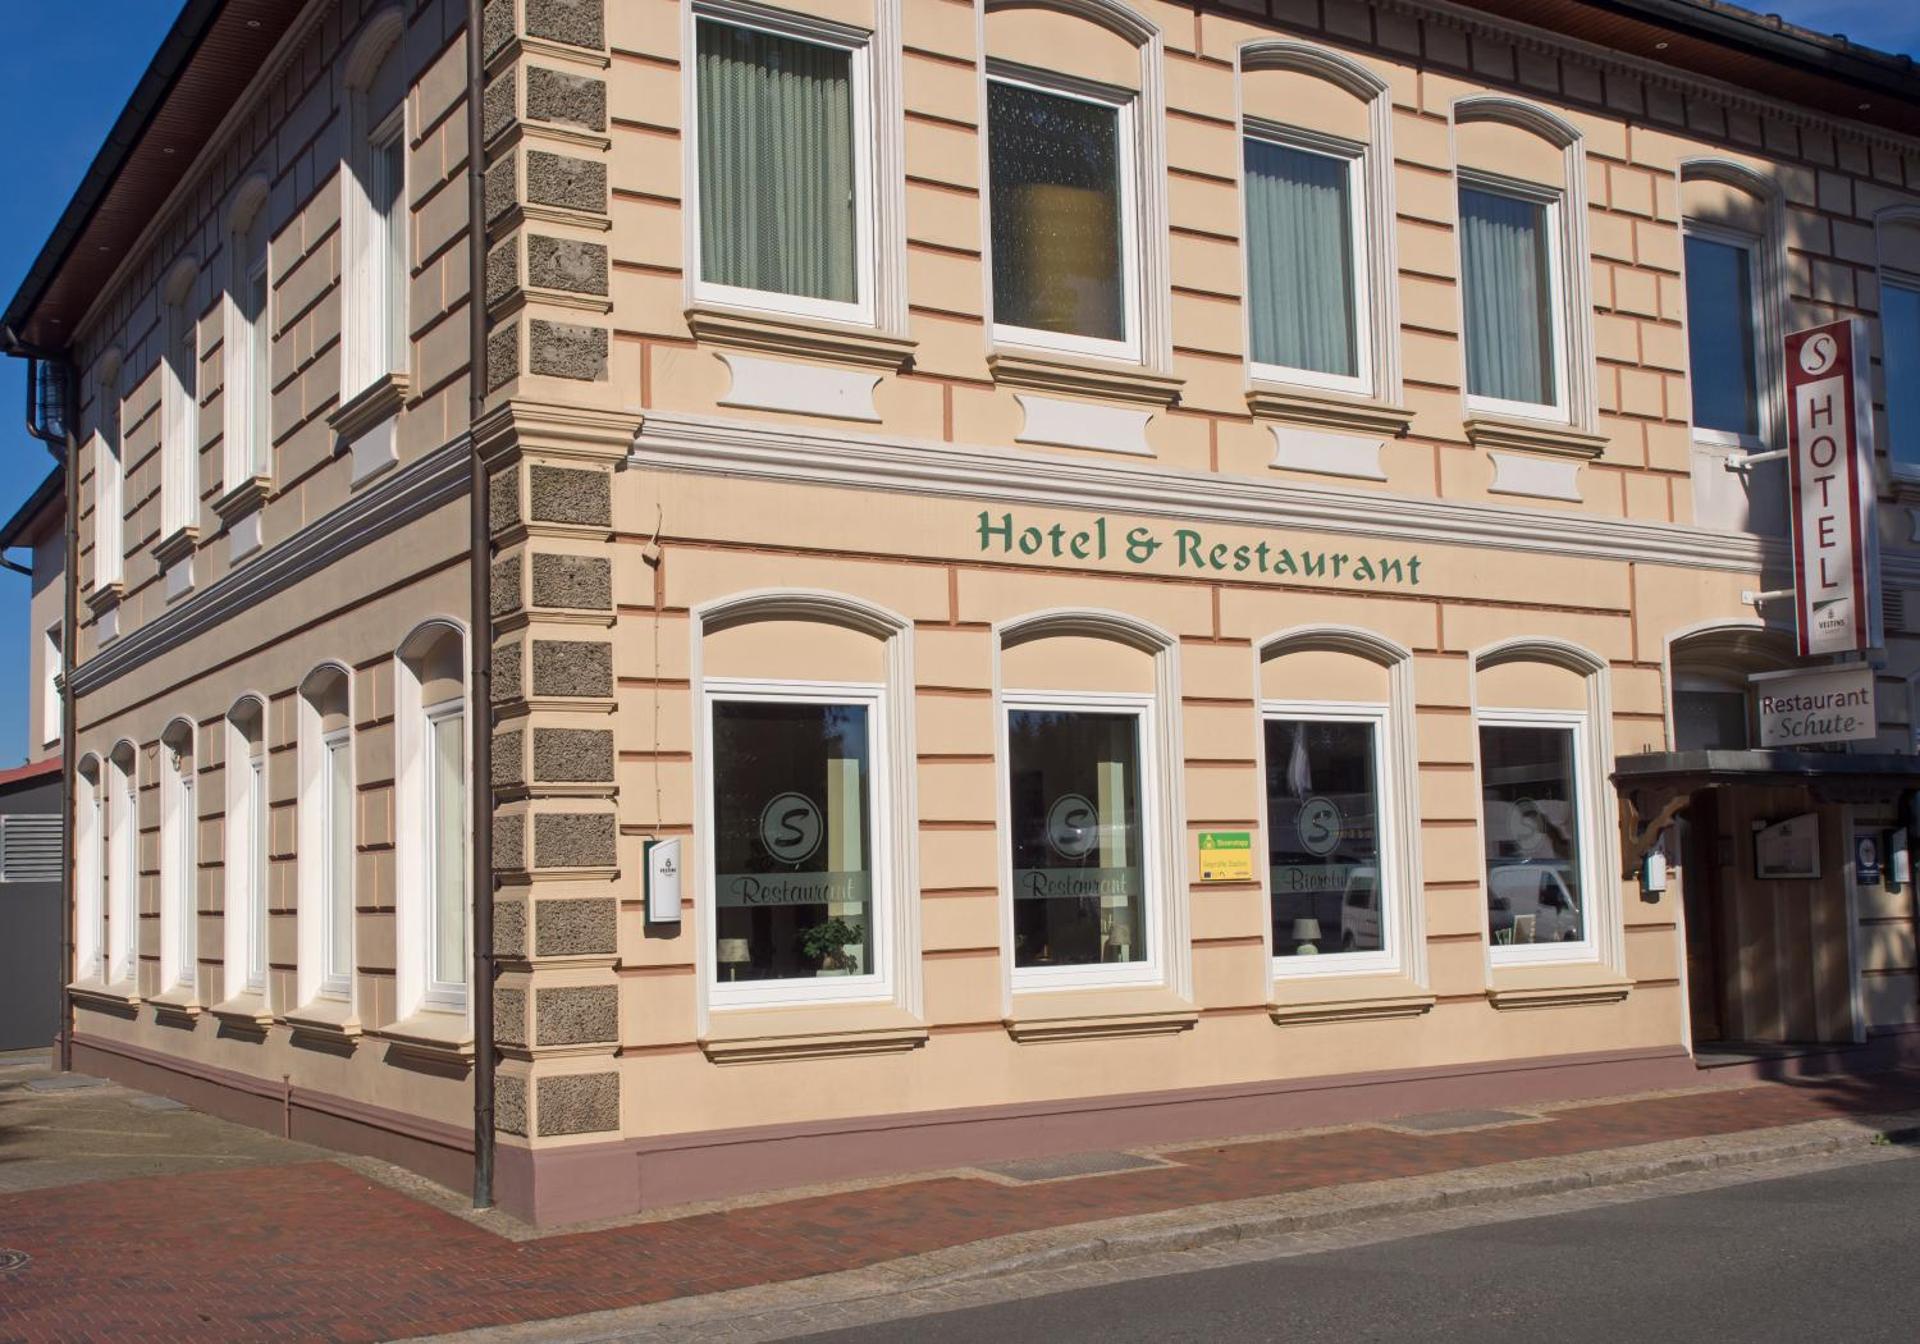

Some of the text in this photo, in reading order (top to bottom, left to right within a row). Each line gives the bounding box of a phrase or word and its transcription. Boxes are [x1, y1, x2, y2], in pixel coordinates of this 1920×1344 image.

[1809, 394, 1839, 590] HOTEL
[976, 509, 1423, 586] Hotel & Restaurant
[1762, 688, 1869, 715] Restaurant
[730, 876, 856, 905] Restaurant
[1022, 871, 1127, 897] Restaurant
